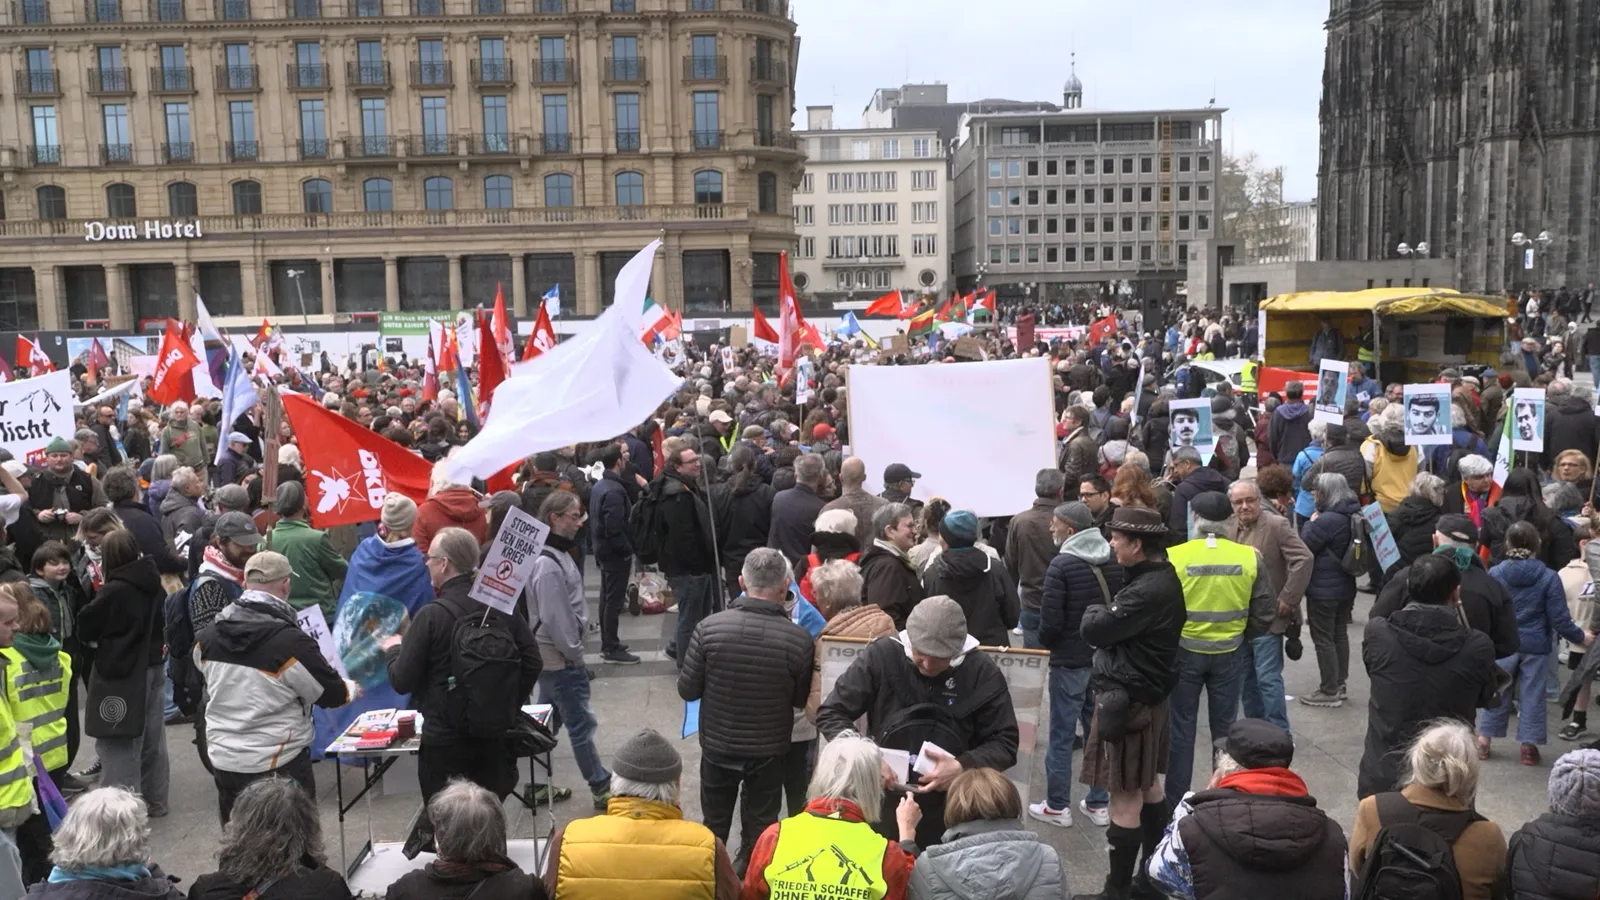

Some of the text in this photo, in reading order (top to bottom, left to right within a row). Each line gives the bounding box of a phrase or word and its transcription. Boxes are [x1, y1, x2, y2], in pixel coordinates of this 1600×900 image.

[84, 219, 203, 242] Dom Hotel
[511, 516, 540, 540] STOPPT
[500, 530, 516, 546] DEN
[514, 538, 536, 556] IRAN-
[501, 545, 525, 565] KRIEG
[774, 890, 810, 900] OHNE
